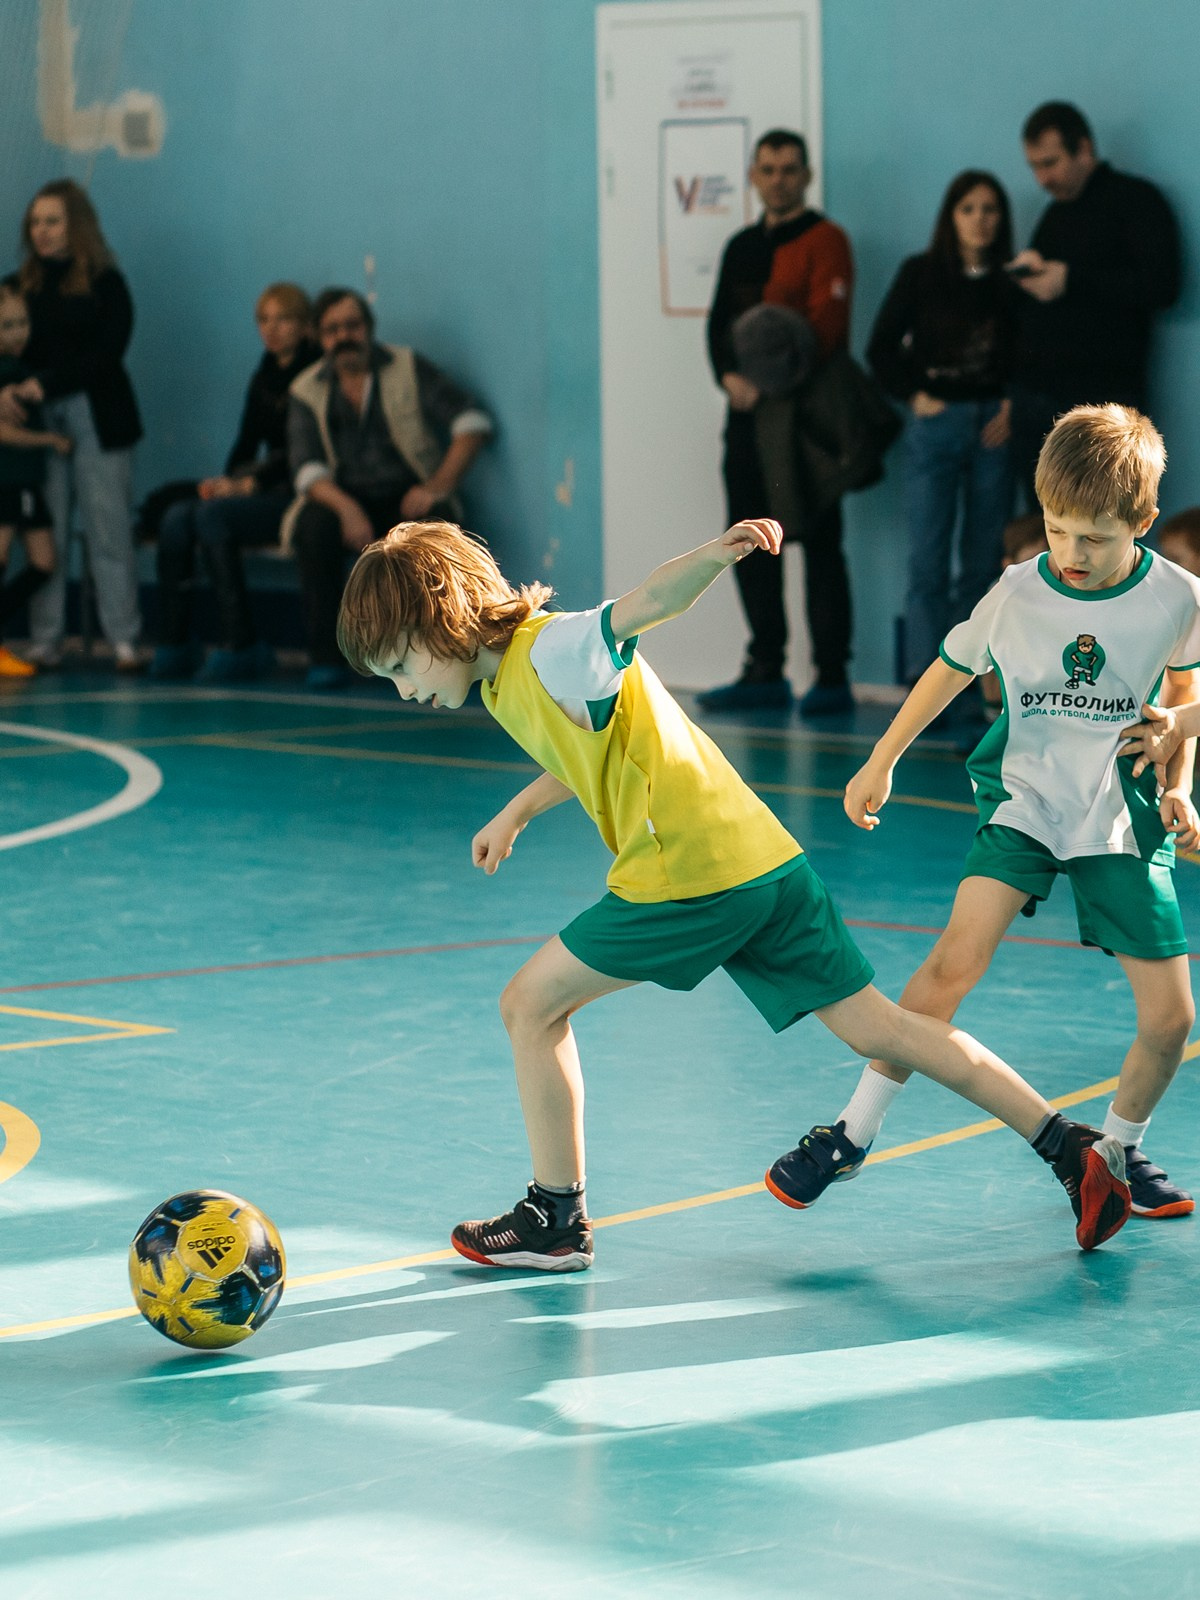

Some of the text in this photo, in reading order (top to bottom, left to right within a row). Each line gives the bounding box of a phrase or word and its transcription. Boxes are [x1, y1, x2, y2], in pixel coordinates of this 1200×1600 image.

[1020, 692, 1136, 714] ФУТБОЛИКА
[1021, 708, 1137, 723] ШКОЛА ФУТБОЛА ДЛЯ ДЕТЕЙ
[186, 1235, 236, 1250] adidas
